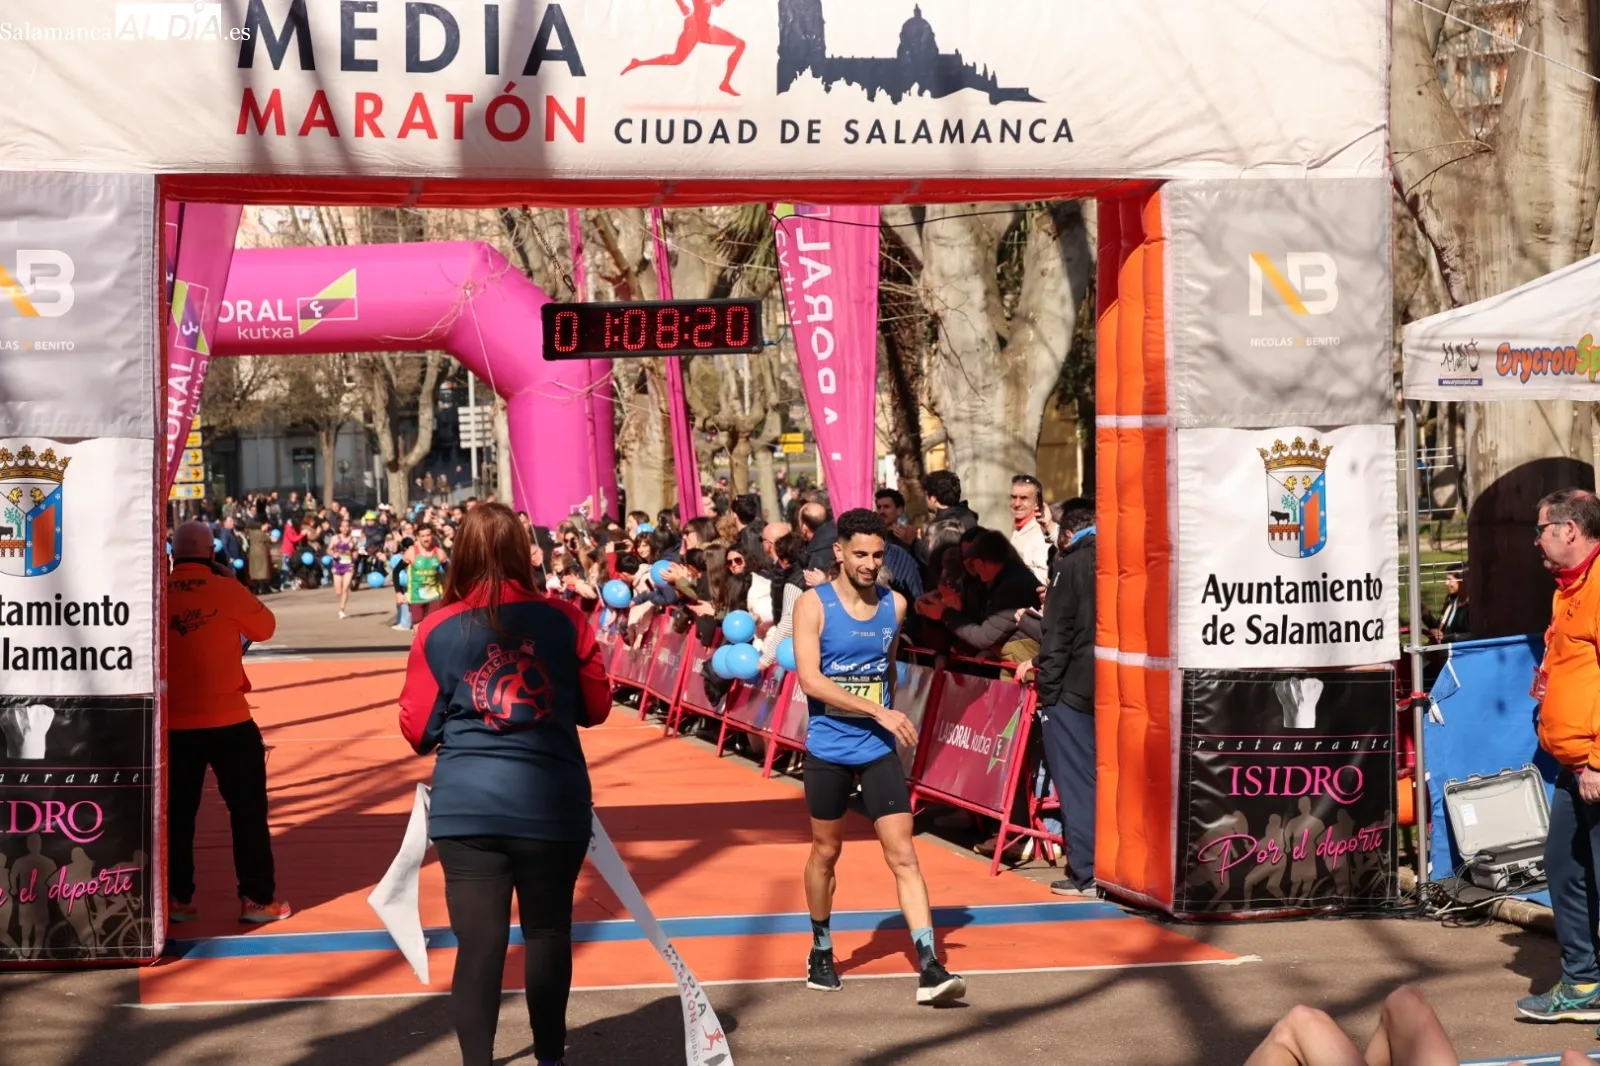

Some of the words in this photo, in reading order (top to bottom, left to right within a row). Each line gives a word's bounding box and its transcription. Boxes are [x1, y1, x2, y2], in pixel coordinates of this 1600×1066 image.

[238, 0, 587, 76] MEDIA
[236, 81, 587, 143] MARATÓN
[614, 118, 759, 144] CIUDAD
[780, 119, 822, 144] DE
[844, 118, 1075, 144] SALAMANCA
[1248, 251, 1339, 316] NB
[34, 341, 75, 351] BENITO
[237, 325, 294, 340] kutxa
[1250, 337, 1293, 347] NICOLAS
[1306, 336, 1340, 346] BENITO
[1201, 572, 1383, 612] Ayuntamiento
[1202, 615, 1235, 645] de
[1245, 614, 1384, 645] Salamanca
[2, 637, 132, 670] lamanca
[938, 720, 972, 750] LABORAL
[1197, 739, 1391, 751] restaurante
[1228, 765, 1364, 804] ISIDRO
[0, 801, 104, 843] DRO
[1198, 834, 1283, 885] Por
[1293, 828, 1309, 860] el
[1316, 825, 1392, 868] deporte
[20, 868, 38, 902] el
[48, 866, 141, 915] deporte
